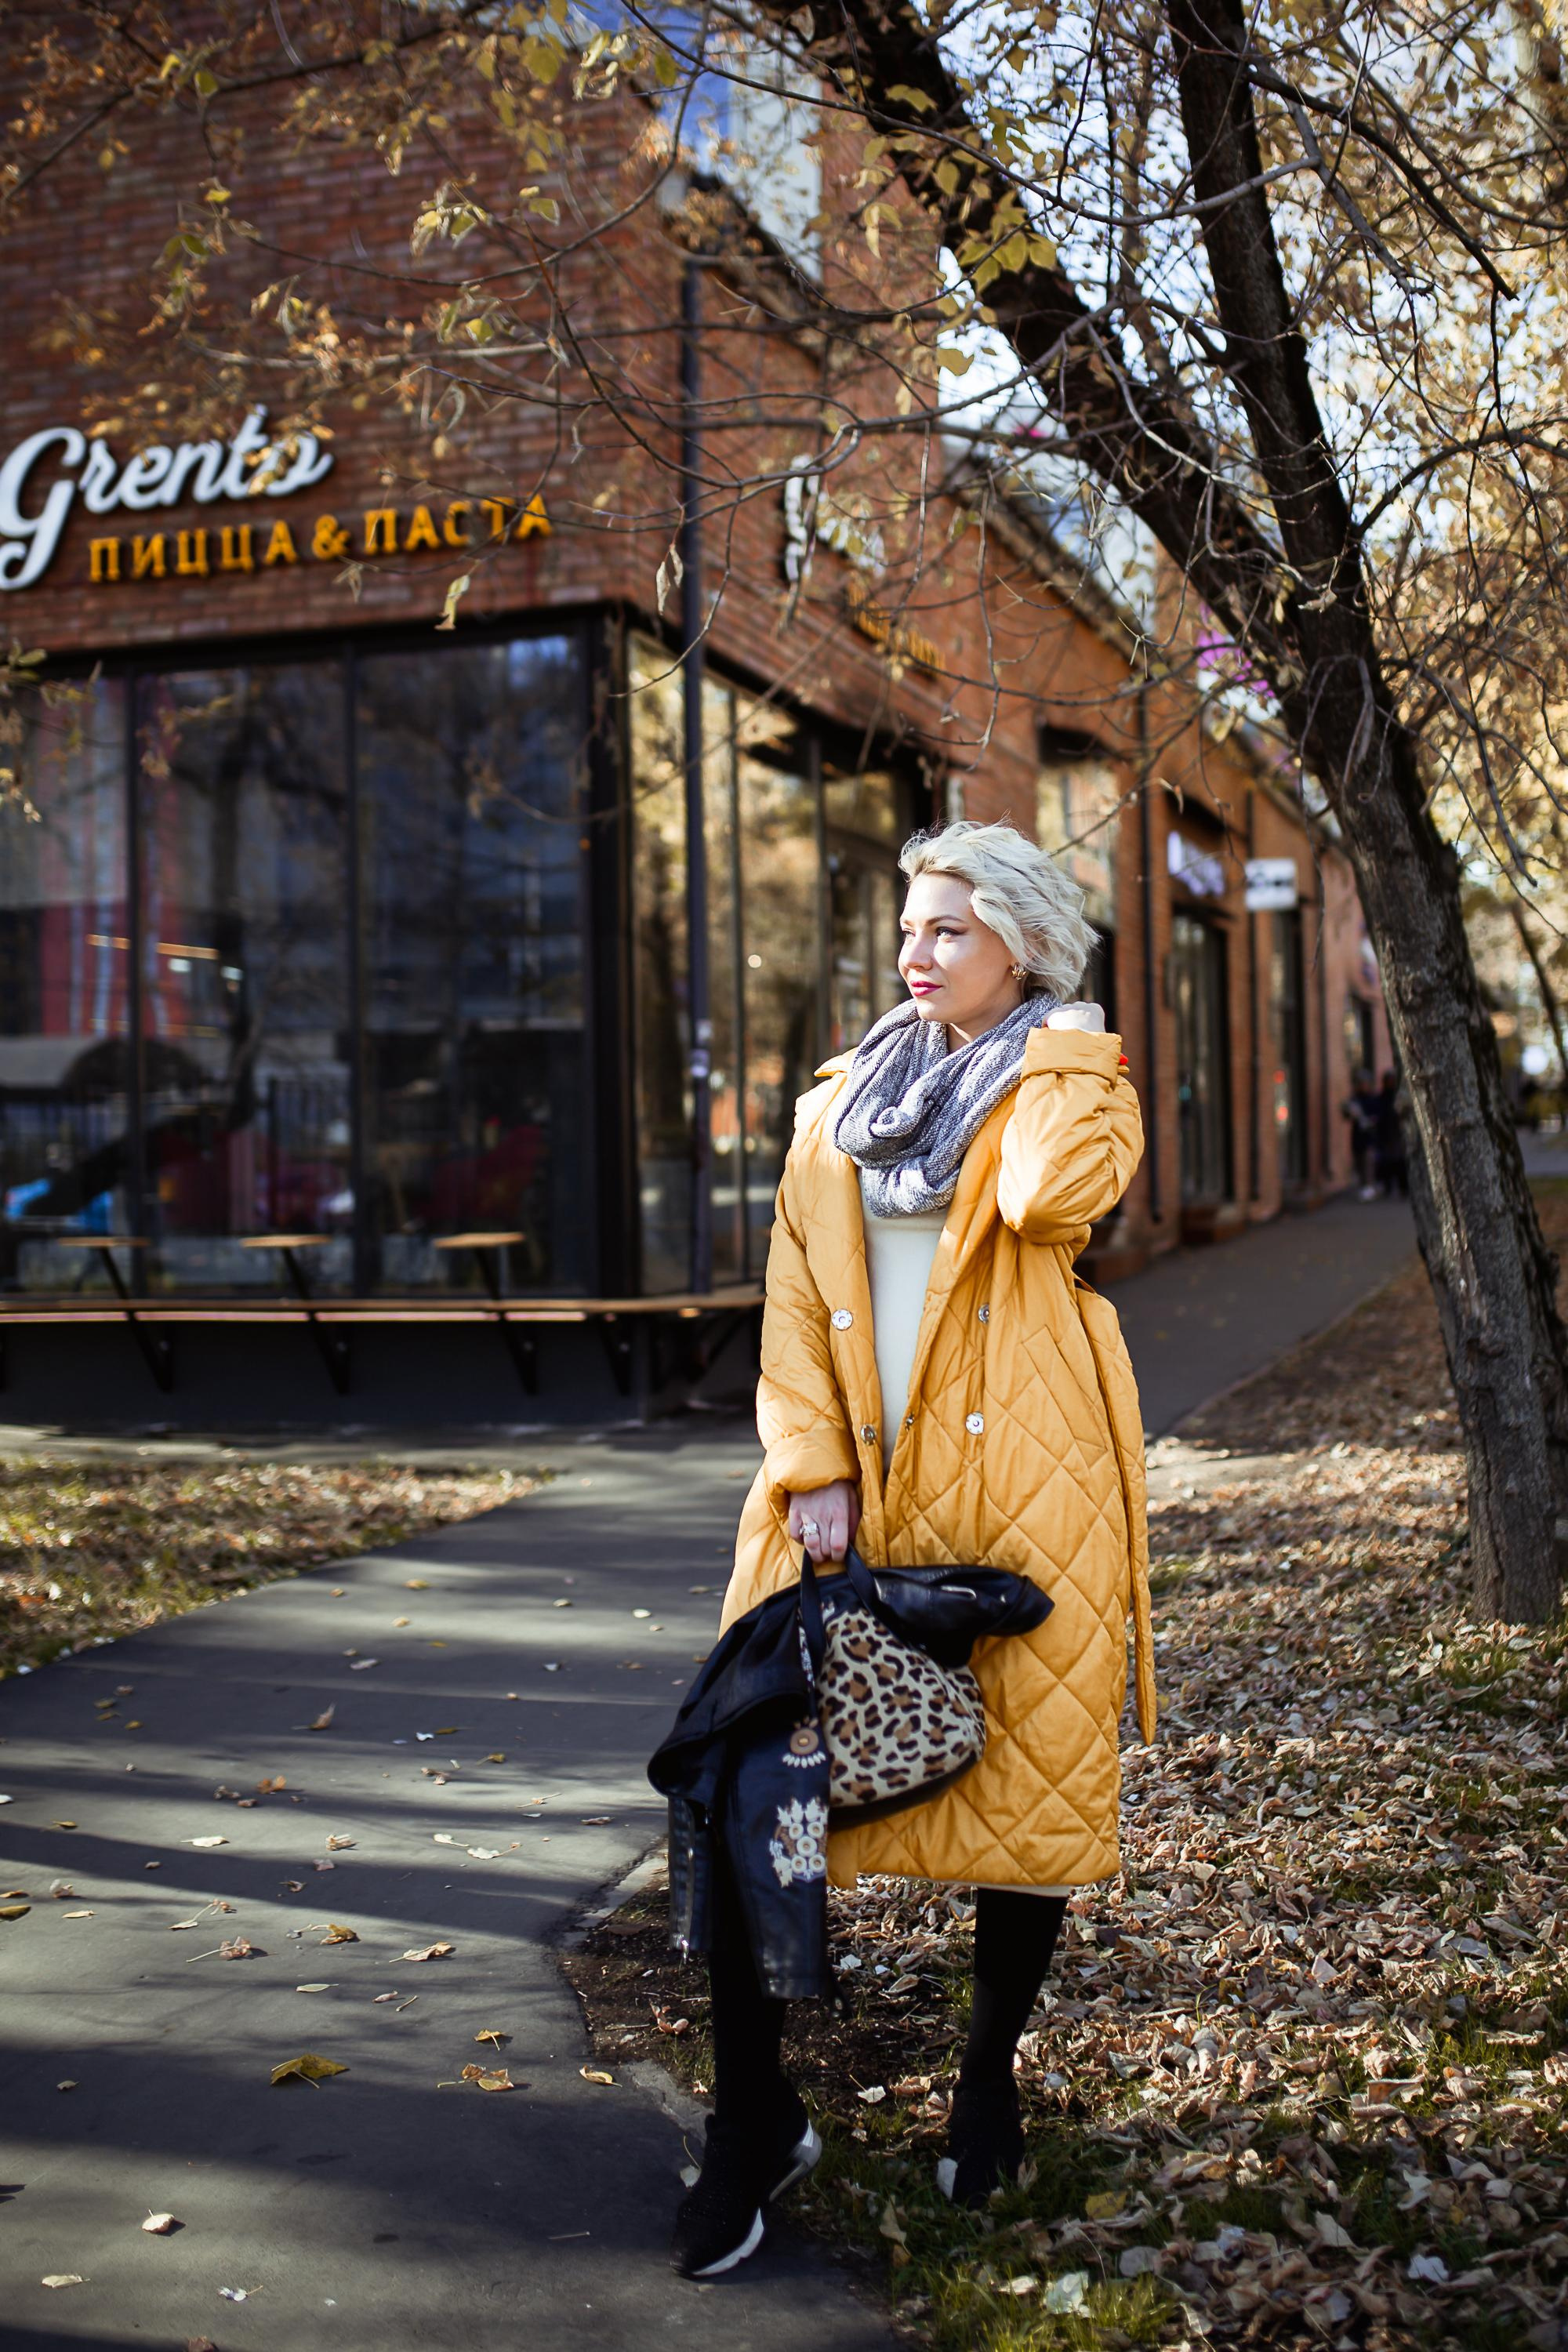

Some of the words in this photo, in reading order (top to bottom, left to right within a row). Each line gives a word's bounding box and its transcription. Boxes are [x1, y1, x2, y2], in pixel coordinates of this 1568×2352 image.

[89, 520, 298, 583] ПИЦЦА
[313, 514, 350, 560] &
[363, 492, 552, 555] ПАСТА
